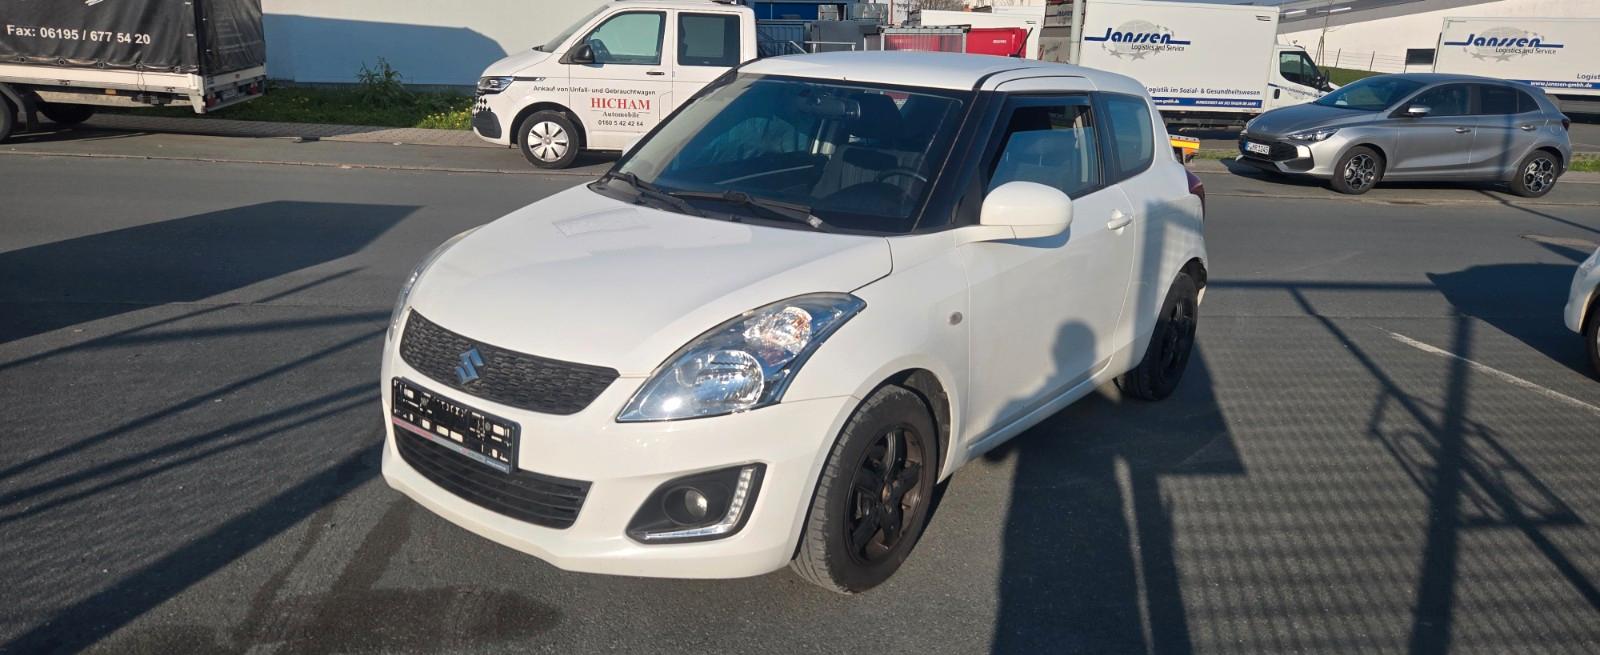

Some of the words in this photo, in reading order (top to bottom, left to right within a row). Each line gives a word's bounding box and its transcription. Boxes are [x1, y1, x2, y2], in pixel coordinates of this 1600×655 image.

[6, 24, 36, 36] Fax:
[40, 27, 79, 40] 06195
[82, 29, 87, 41] /
[90, 31, 112, 42] 677
[116, 32, 131, 43] 54
[135, 33, 151, 45] 20
[1099, 28, 1177, 44] Janssen
[1459, 33, 1548, 48] Janssen
[1495, 47, 1521, 55] Logistics
[604, 88, 656, 96] Gebrauchtwagen
[591, 97, 651, 110] HICHAM
